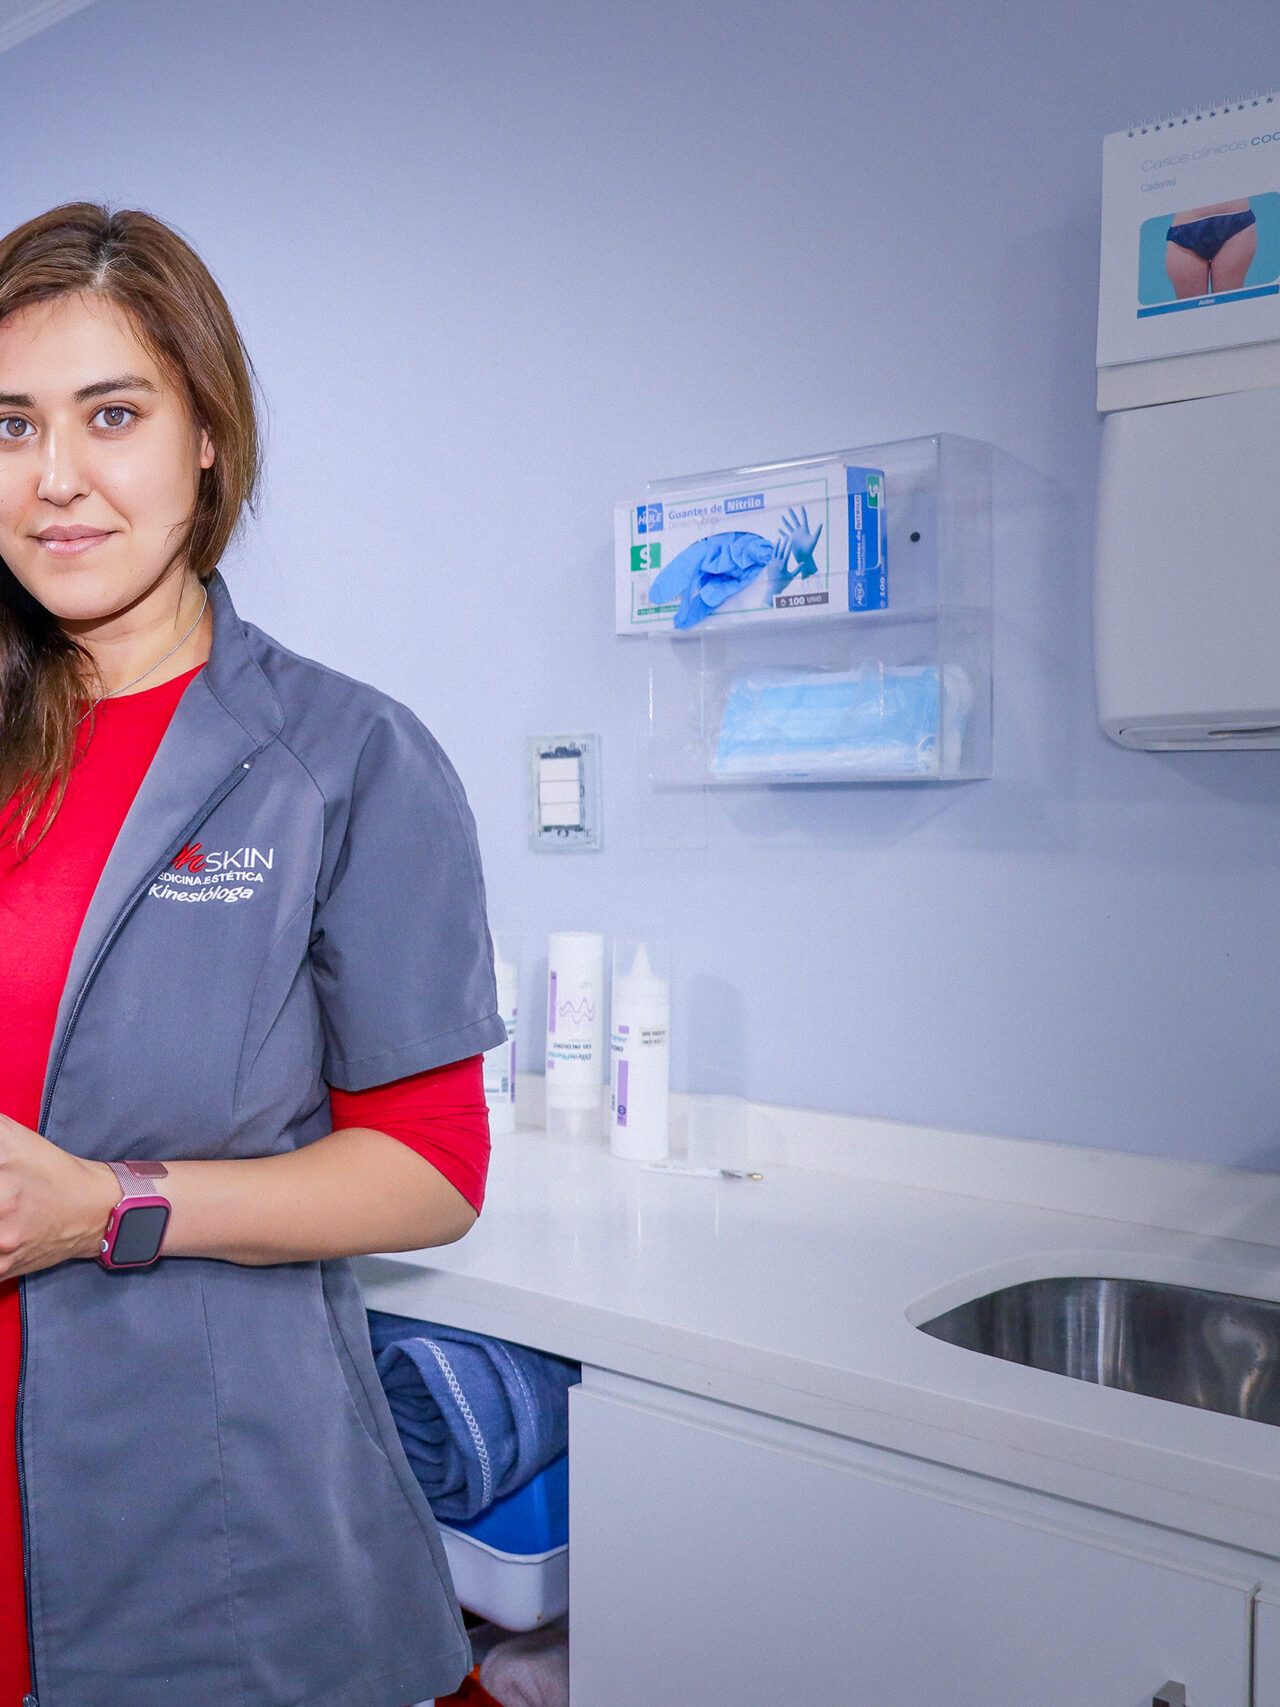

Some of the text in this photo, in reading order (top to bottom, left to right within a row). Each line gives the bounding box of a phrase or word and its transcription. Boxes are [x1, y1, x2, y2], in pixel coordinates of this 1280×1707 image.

[1141, 154, 1189, 172] Casos
[1141, 179, 1177, 192] Caderas
[867, 483, 879, 498] S
[668, 497, 762, 520] Guantes de Nitrilo
[855, 530, 862, 541] de
[639, 546, 651, 569] S
[789, 596, 806, 606] 100
[205, 847, 274, 872] SKIN
[158, 870, 264, 886] EDICINA ESTÉTICA
[148, 883, 254, 903] Kinesióloga
